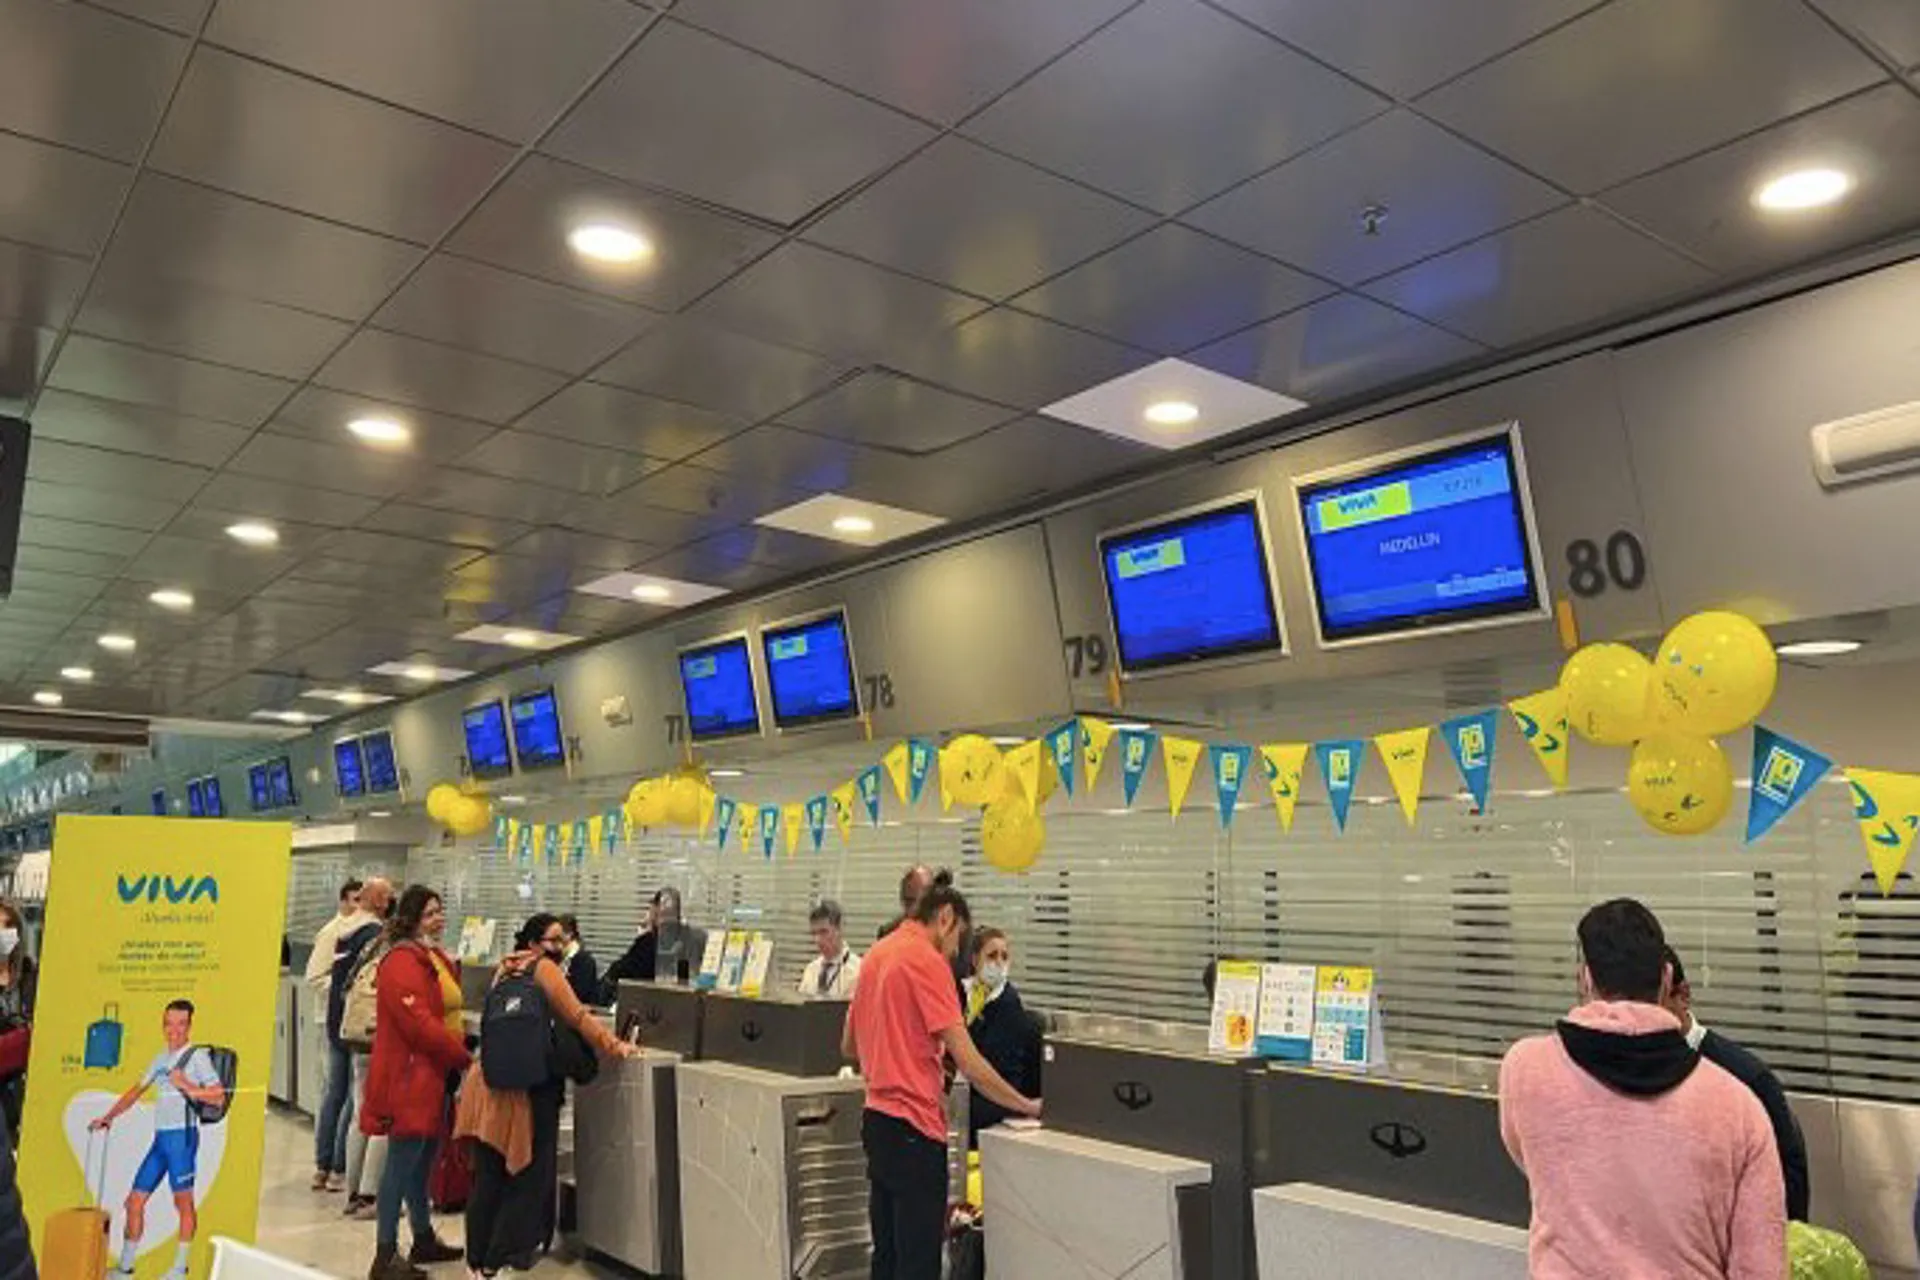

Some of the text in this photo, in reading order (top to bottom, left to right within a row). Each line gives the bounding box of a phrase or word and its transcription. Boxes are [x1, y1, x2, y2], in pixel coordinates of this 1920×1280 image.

[1565, 529, 1646, 599] 80
[1064, 634, 1108, 679] 79
[864, 674, 894, 713] 78
[117, 873, 219, 904] VIVA
